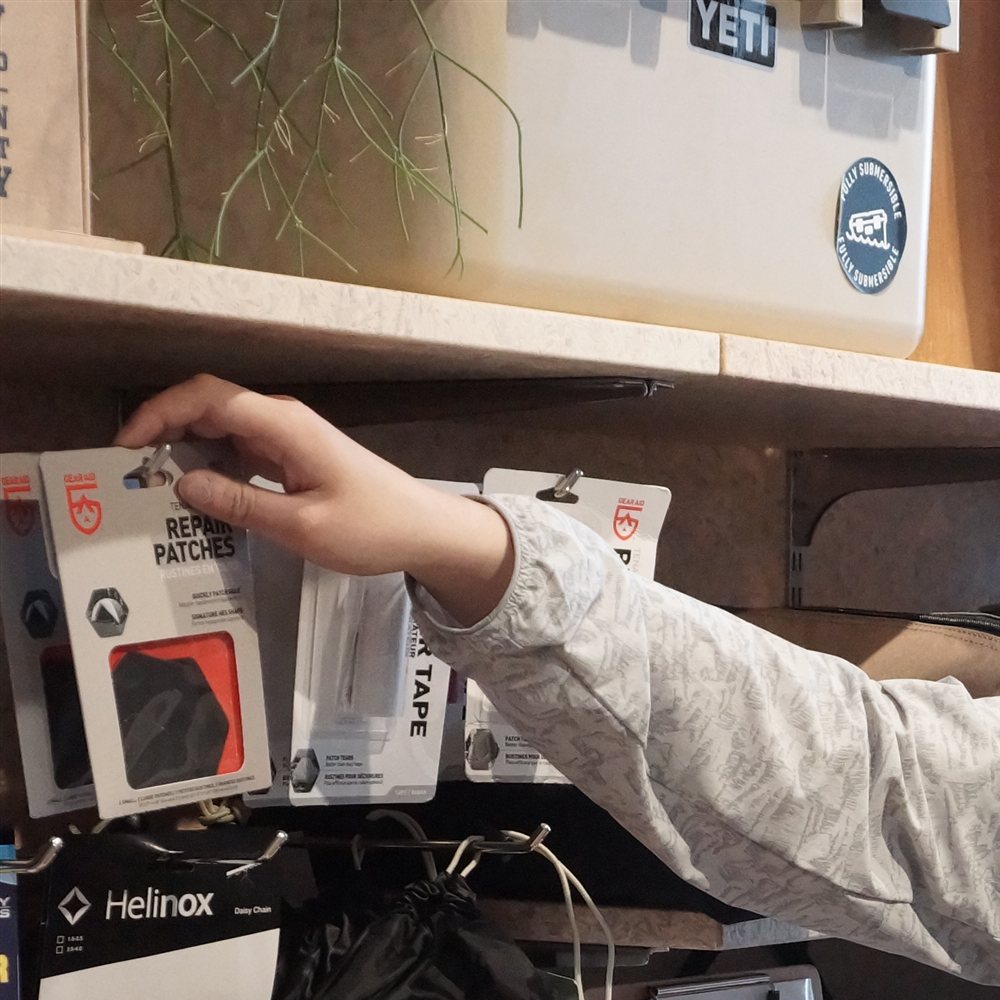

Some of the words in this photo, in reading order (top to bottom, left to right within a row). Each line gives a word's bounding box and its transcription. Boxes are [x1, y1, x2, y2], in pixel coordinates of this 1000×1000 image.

[696, 0, 769, 57] YETI
[840, 167, 858, 201] FULLY
[859, 162, 902, 220] SUBMERSIBLE
[838, 236, 855, 273] FULLY
[854, 246, 899, 288] SUBMERSIBLE
[153, 537, 235, 565] PATCHES
[409, 624, 418, 658] ATEUR
[410, 664, 432, 737] TAPE
[105, 887, 215, 920] Helinox
[235, 906, 252, 916] Daisy
[253, 905, 272, 914] Chain
